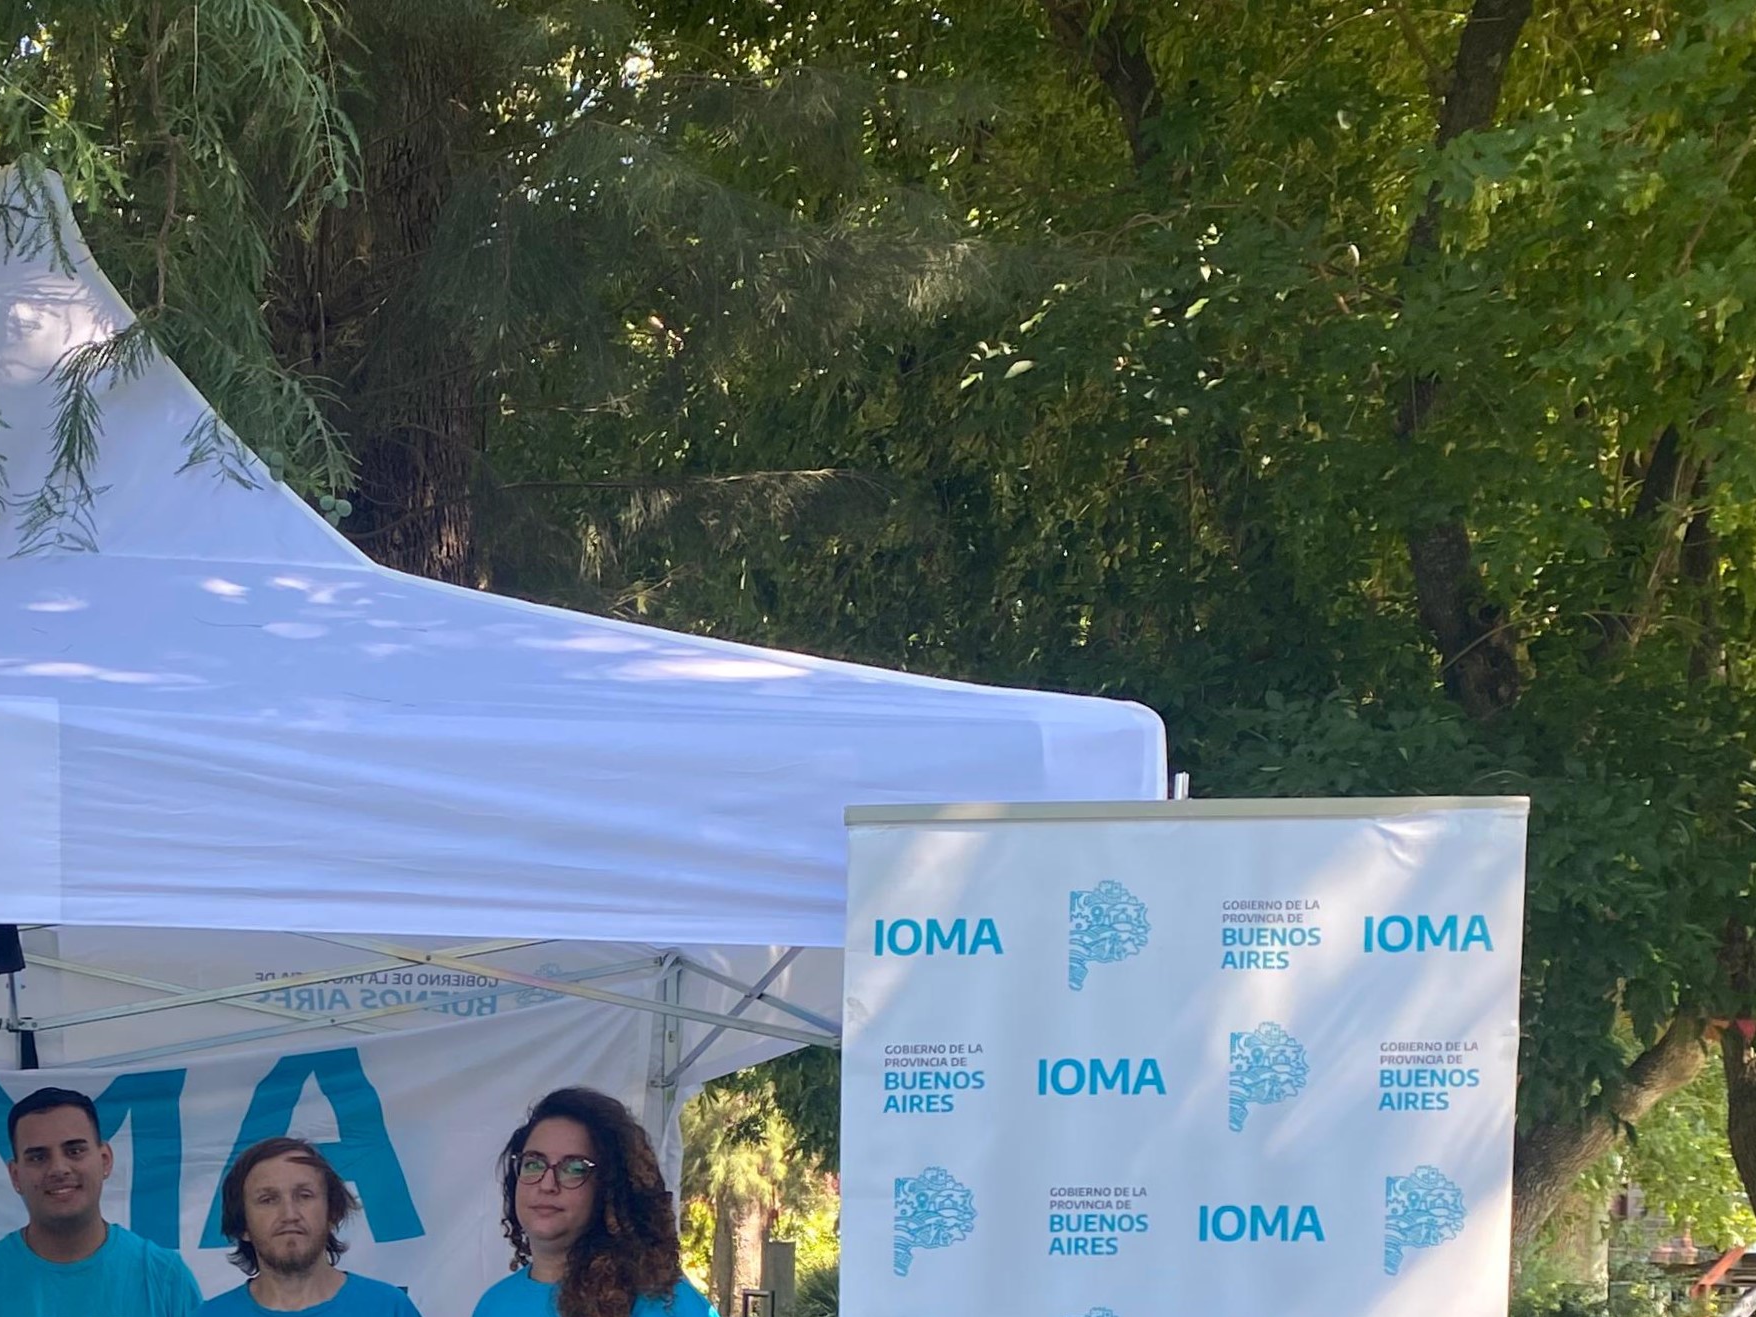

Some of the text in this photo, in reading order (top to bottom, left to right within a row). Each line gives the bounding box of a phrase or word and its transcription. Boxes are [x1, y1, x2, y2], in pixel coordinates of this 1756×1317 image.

[1222, 900, 1320, 910] GOBIERNO DE LA
[1222, 913, 1303, 923] PROVINCIA DE
[874, 918, 1004, 956] IOMA
[1221, 927, 1321, 946] BUENOS
[1363, 914, 1494, 953] IOMA
[1221, 950, 1289, 970] AIRES
[884, 1044, 983, 1055] GOBIERNO DE LA
[884, 1057, 967, 1067] PROVINCIA DE
[884, 1071, 984, 1090] BUENOS
[1038, 1058, 1166, 1096] IOMA
[883, 1094, 953, 1113] AIRES
[1198, 1204, 1325, 1243] IOMA
